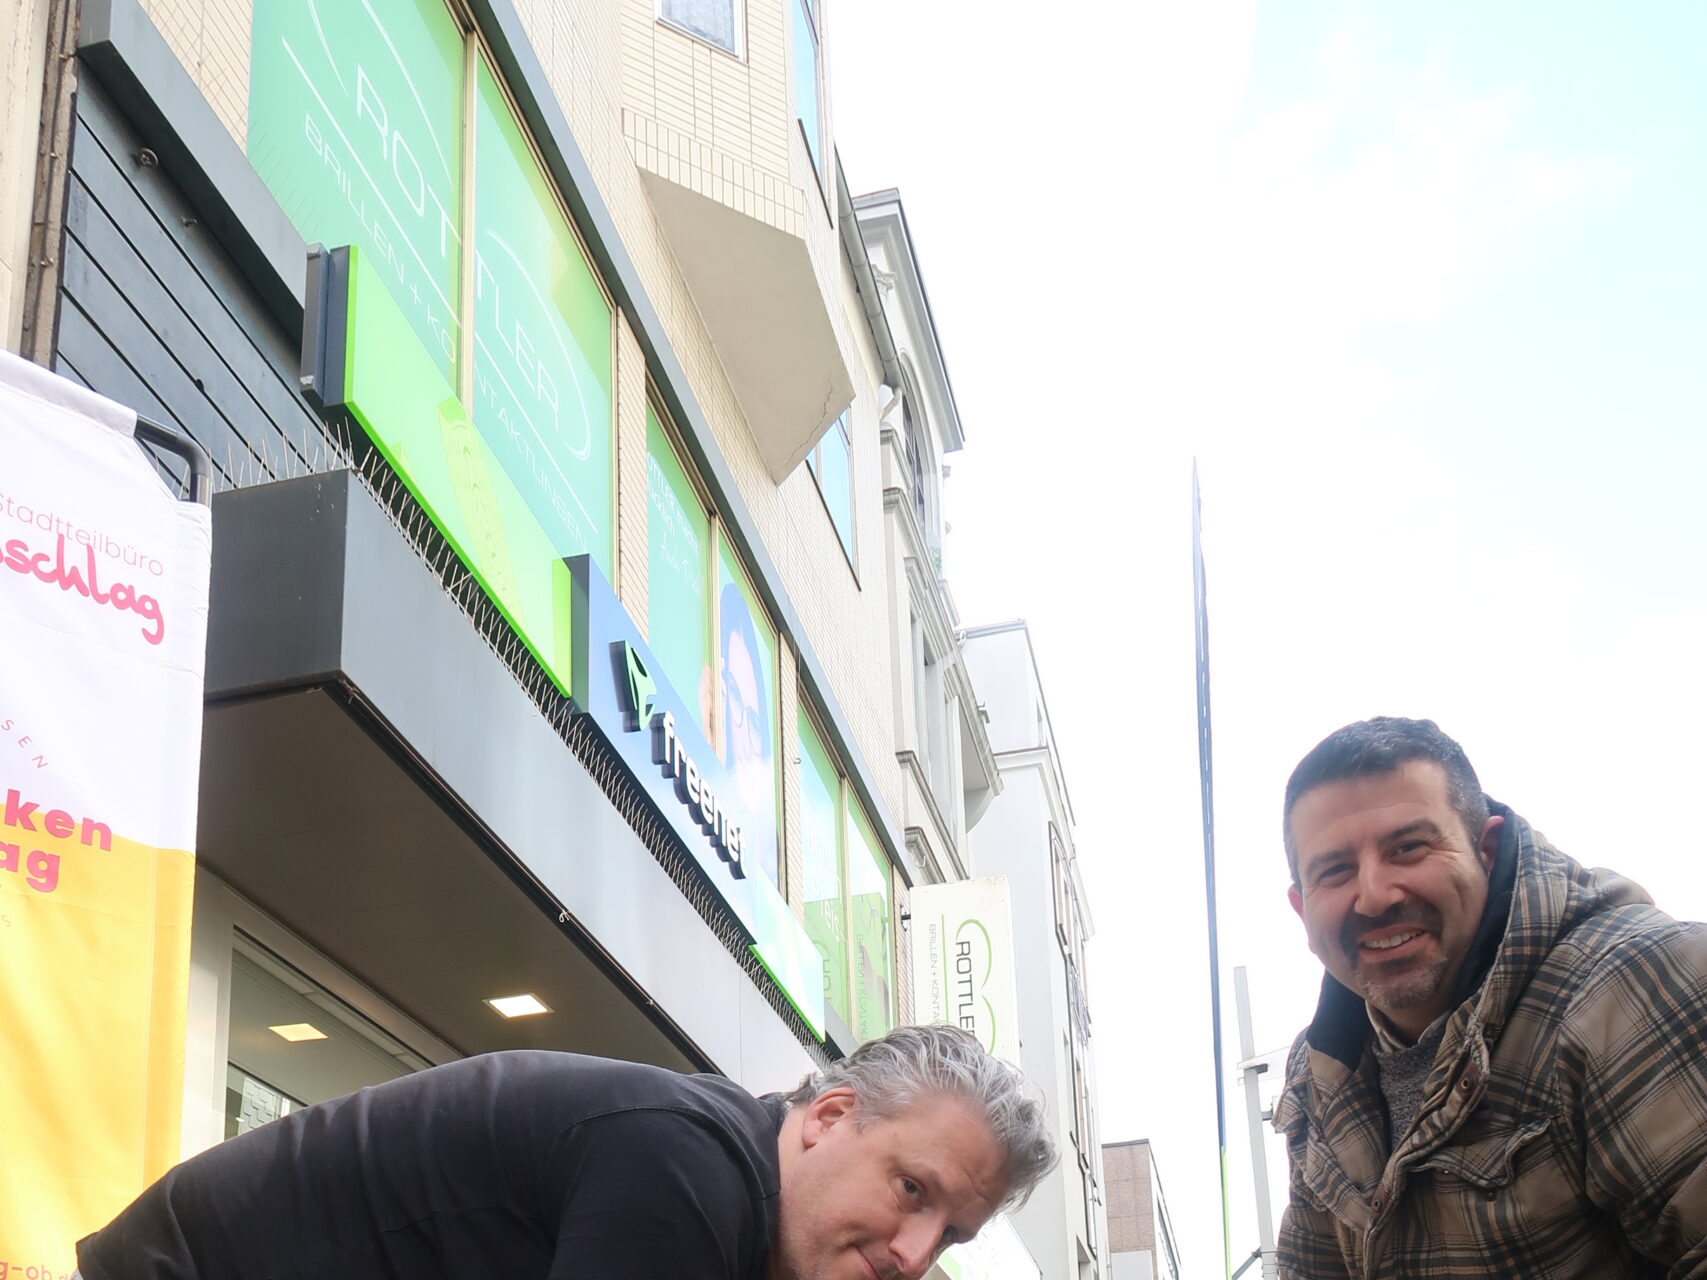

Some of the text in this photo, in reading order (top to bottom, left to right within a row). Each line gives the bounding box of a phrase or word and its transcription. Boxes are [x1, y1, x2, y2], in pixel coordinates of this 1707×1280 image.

[304, 112, 405, 285] BRILLEN
[356, 64, 561, 431] ROTTLER
[0, 534, 165, 645] schlag
[657, 710, 747, 880] freenet
[928, 923, 938, 968] BRILLEN
